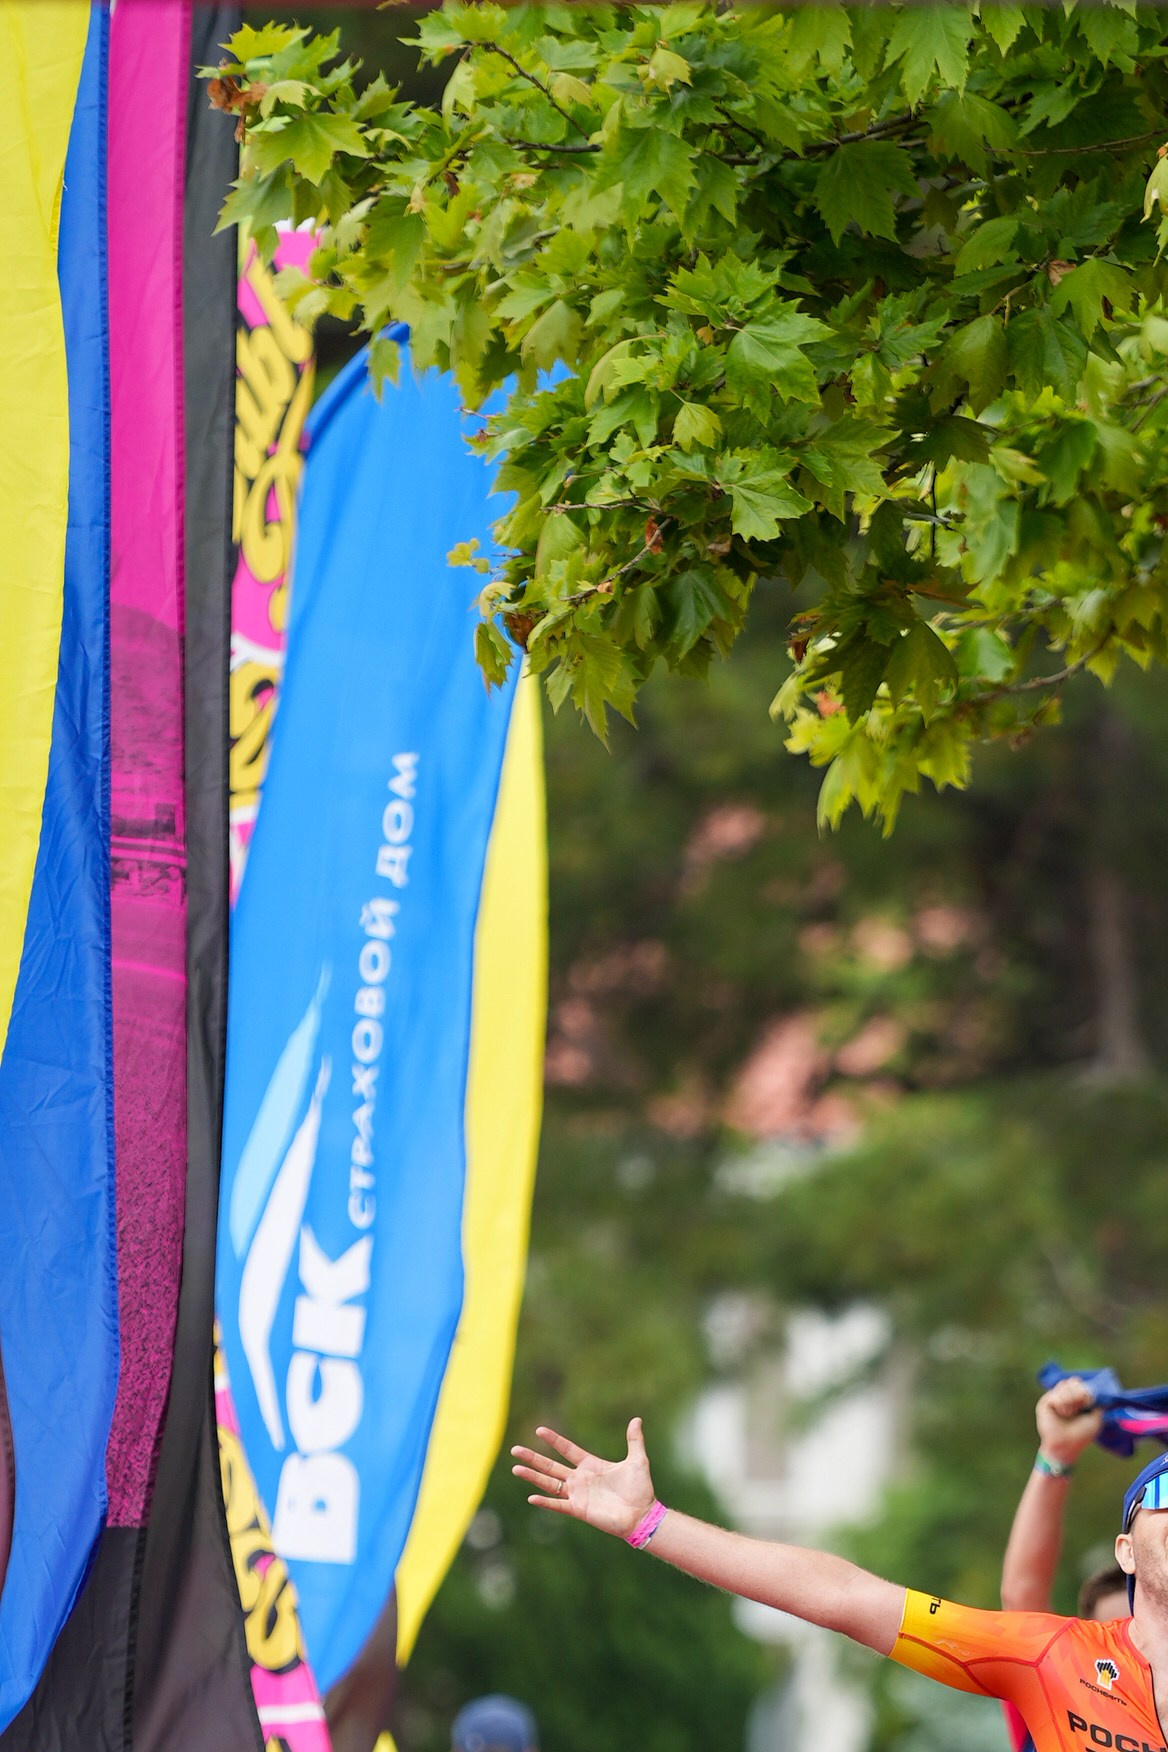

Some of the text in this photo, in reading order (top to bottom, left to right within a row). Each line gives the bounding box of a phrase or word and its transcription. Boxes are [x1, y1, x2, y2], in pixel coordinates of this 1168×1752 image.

[347, 751, 420, 1231] СТРАХОВОЙ ДОМ
[272, 1224, 374, 1565] ВСК
[1079, 1678, 1128, 1707] РОСНЕФТЬ
